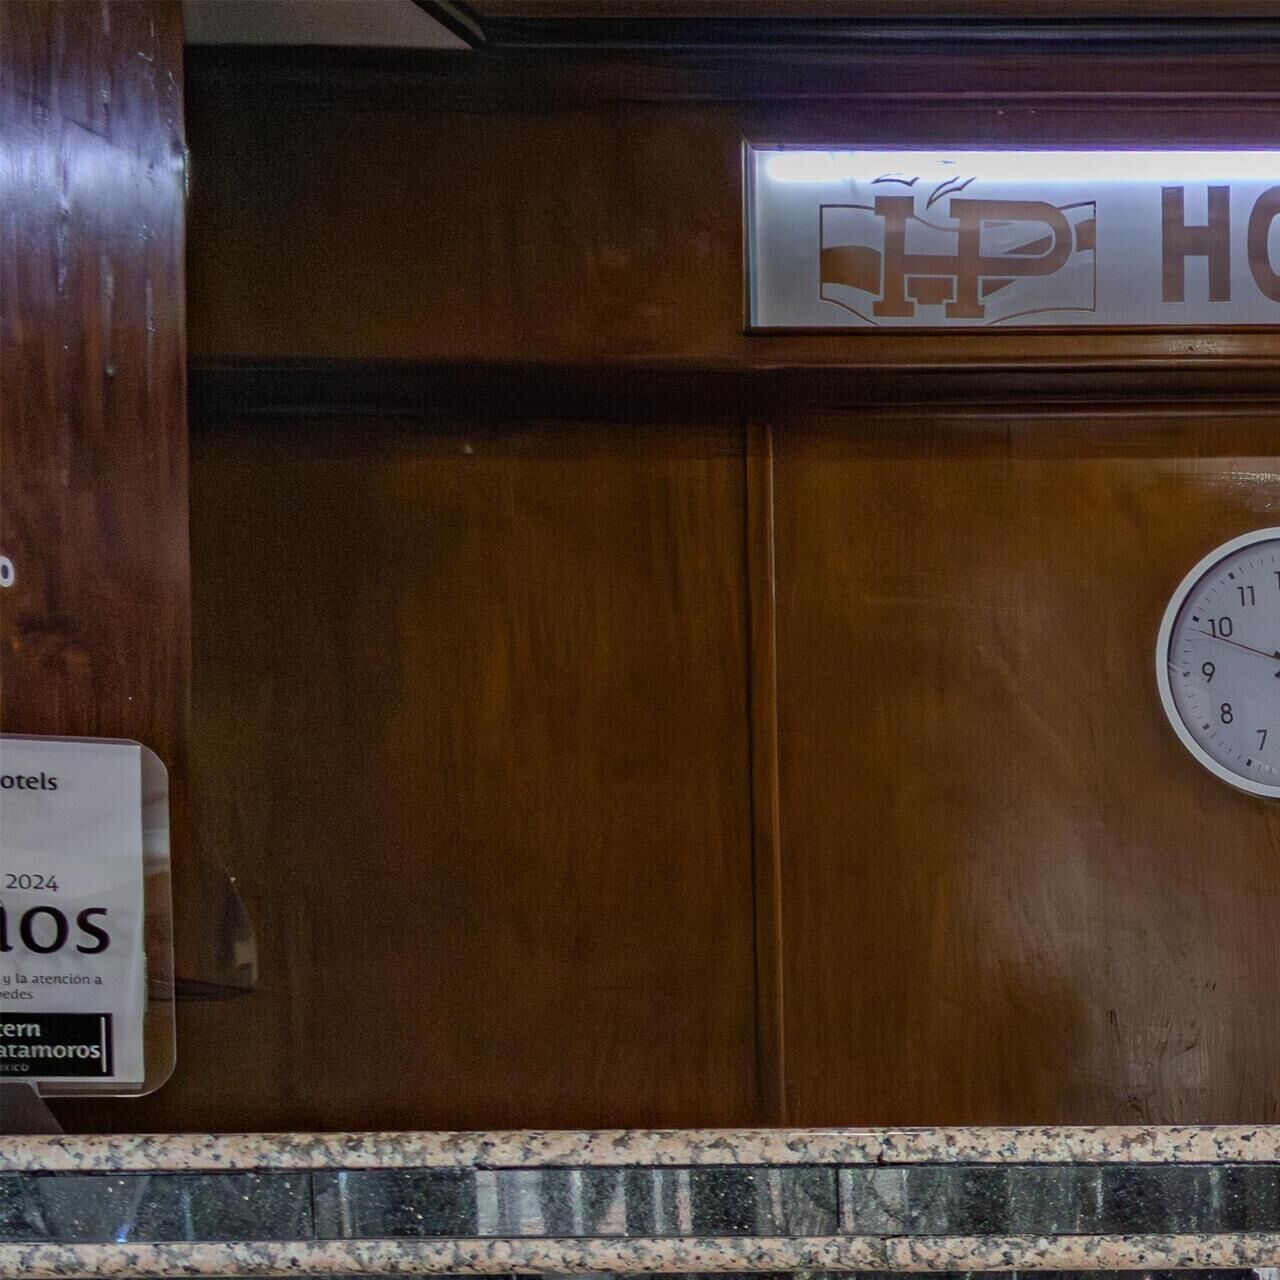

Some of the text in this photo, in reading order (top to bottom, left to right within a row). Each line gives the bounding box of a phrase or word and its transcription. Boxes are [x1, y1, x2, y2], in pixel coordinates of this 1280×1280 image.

[1237, 586, 1256, 606] 11
[1208, 616, 1233, 638] 10
[1202, 661, 1216, 683] 9
[1220, 702, 1234, 724] 8
[1256, 729, 1268, 750] 7
[5, 873, 59, 892] 2024
[3, 972, 103, 986] y la atención a
